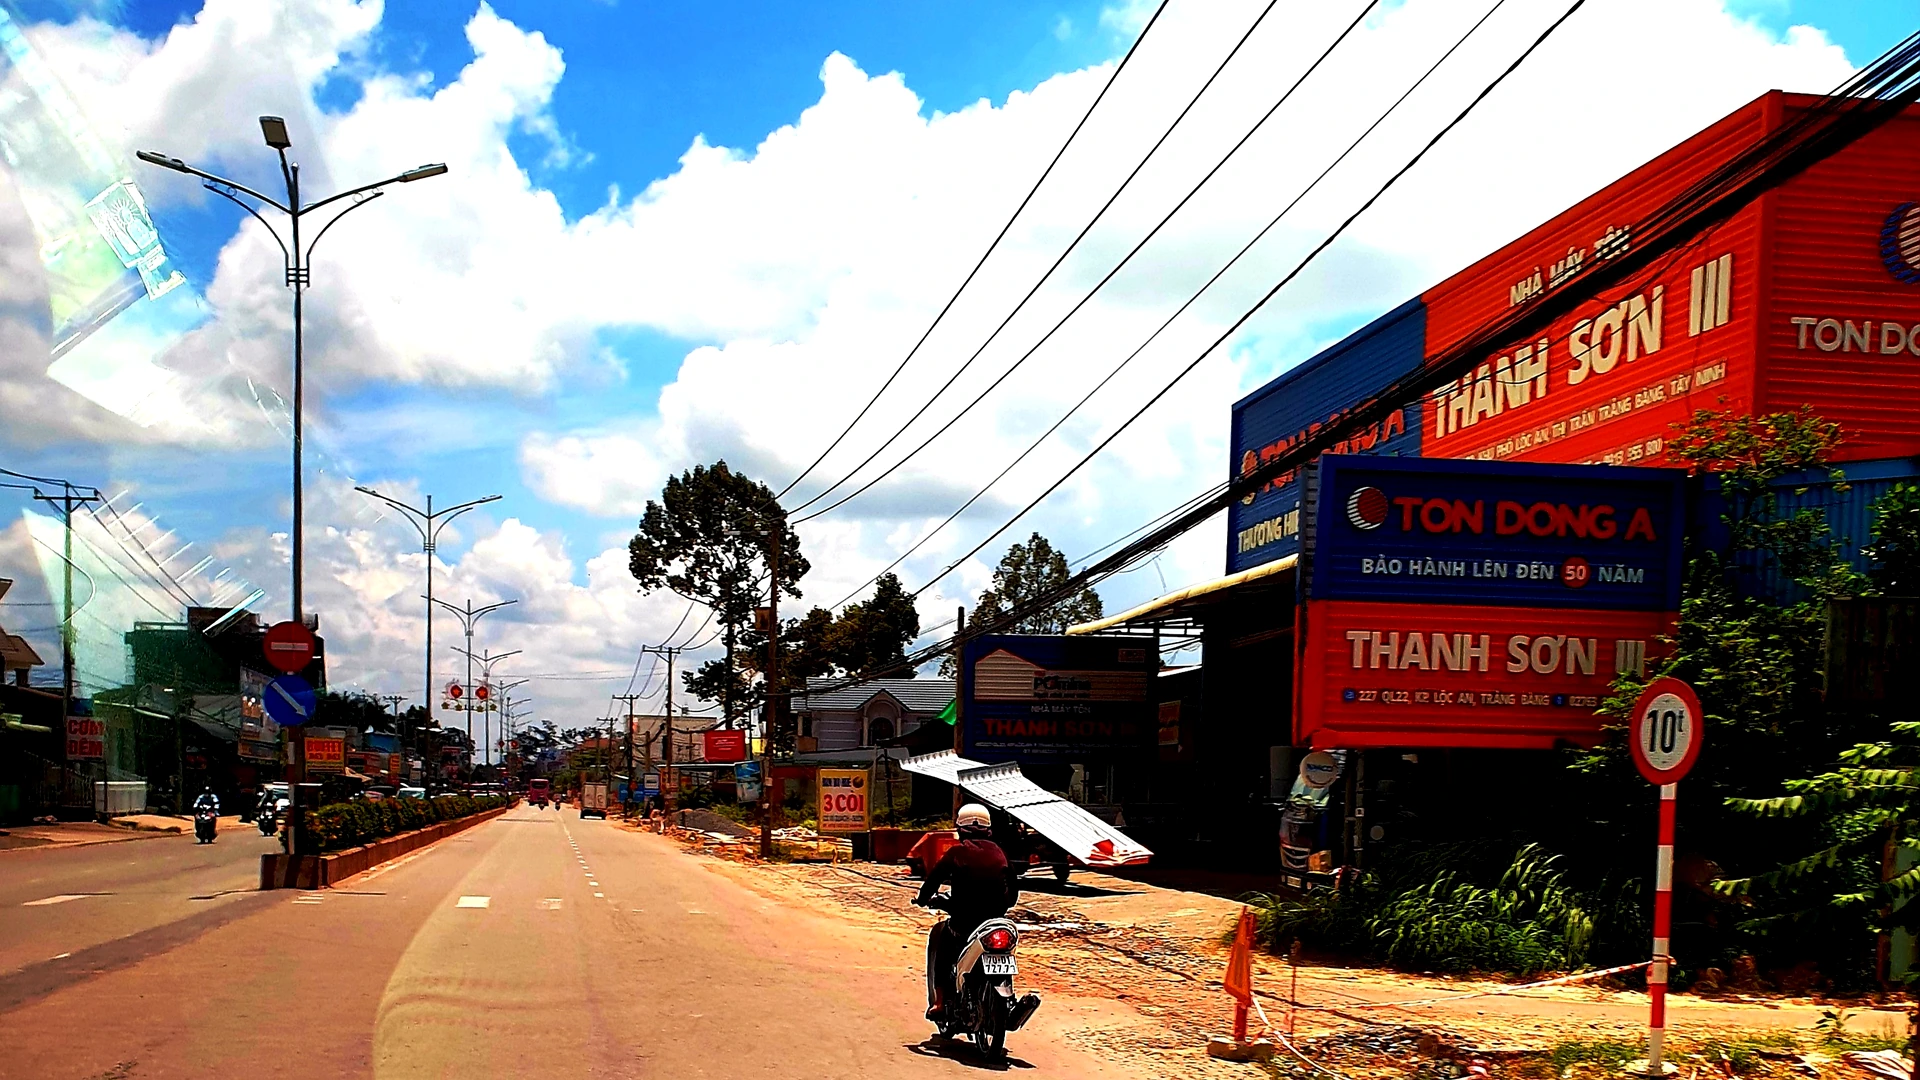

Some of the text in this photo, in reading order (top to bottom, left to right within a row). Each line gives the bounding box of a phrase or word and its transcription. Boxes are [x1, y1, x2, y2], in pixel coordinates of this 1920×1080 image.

[1433, 337, 1549, 439] THANH
[1567, 285, 1664, 385] SƠN
[1688, 253, 1732, 337] III
[1790, 317, 1872, 353] TON
[1670, 374, 1692, 395] TÂY
[1392, 496, 1658, 542] TON DONG A
[1361, 554, 1645, 583] BẢO HÀNH LÊN ĐẾN 50 NĂM
[1346, 630, 1646, 676] THANH SƠN III
[1358, 690, 1378, 702] 227
[1433, 689, 1454, 706] LỘC
[982, 718, 1058, 737] THANH
[823, 794, 833, 812] 3
